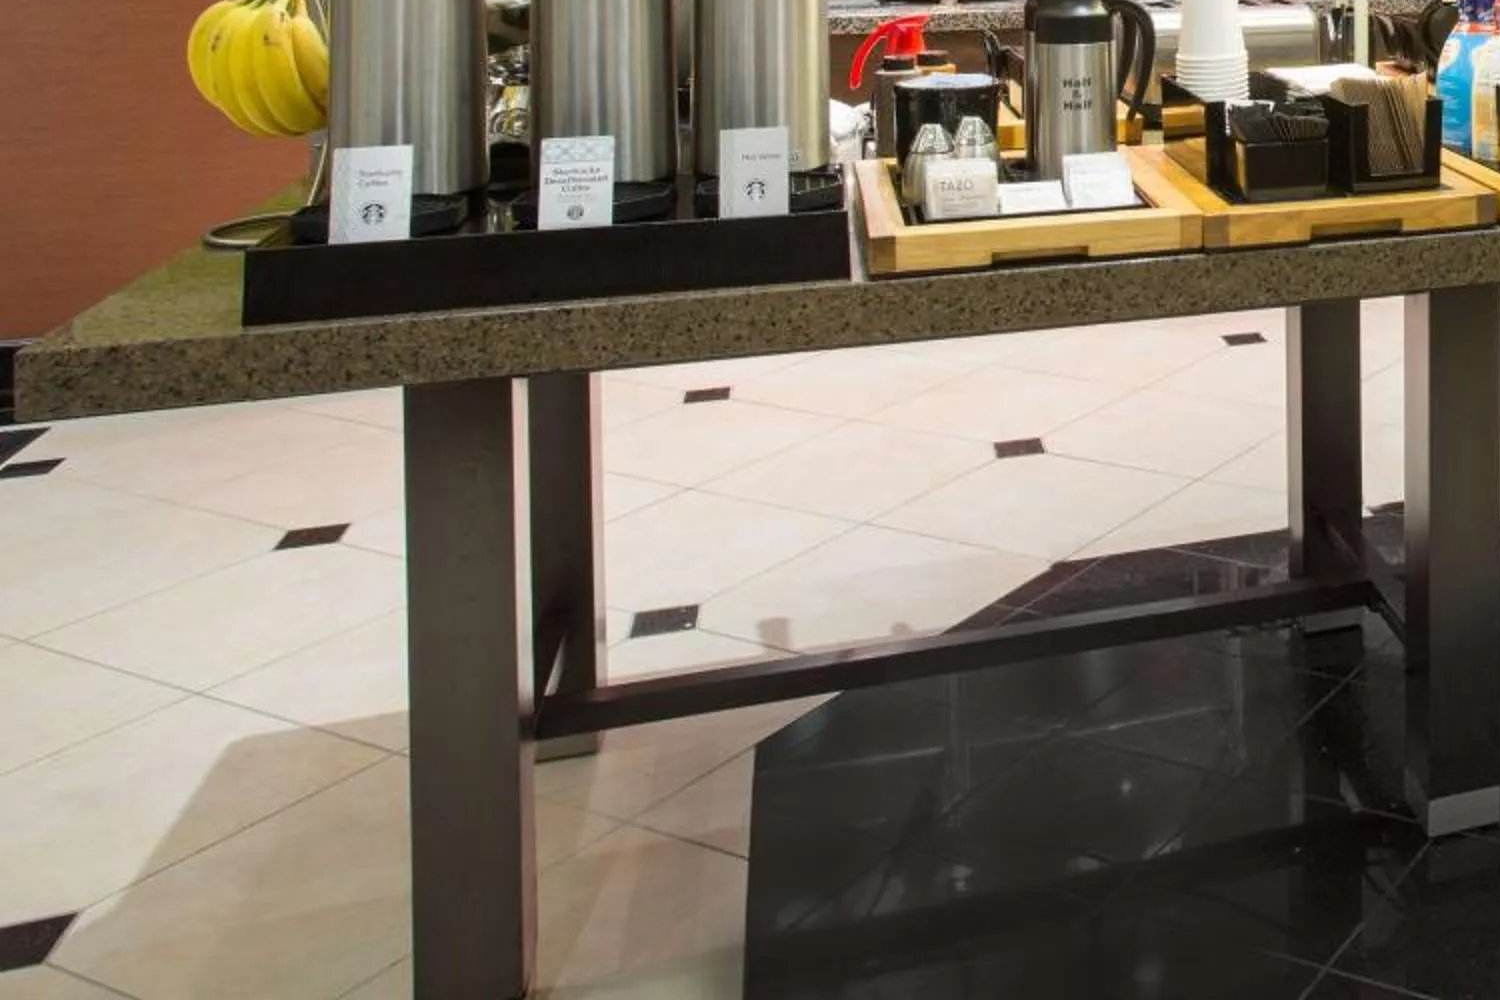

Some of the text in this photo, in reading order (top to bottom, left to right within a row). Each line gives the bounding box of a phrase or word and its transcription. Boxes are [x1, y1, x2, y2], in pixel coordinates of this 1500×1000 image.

[1062, 77, 1092, 88] Half
[1062, 100, 1092, 110] Half
[939, 179, 974, 193] TAZO
